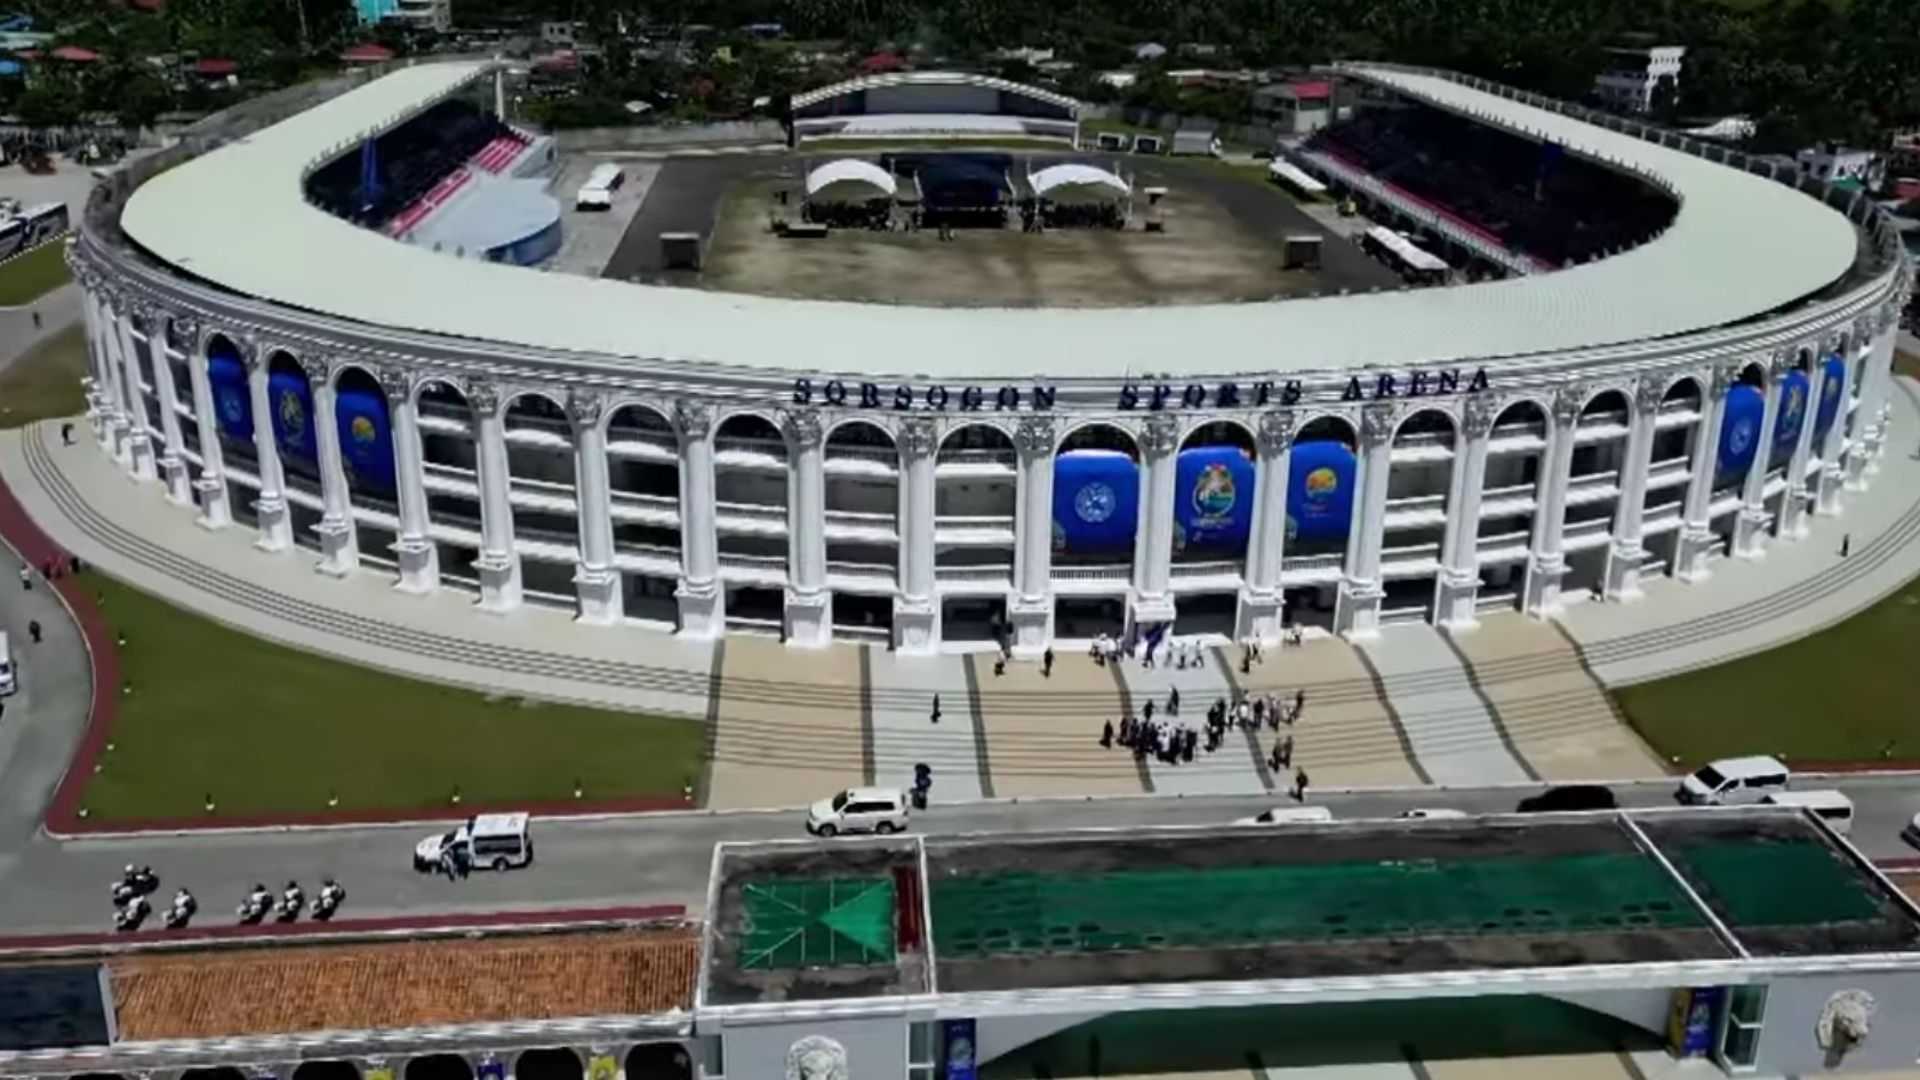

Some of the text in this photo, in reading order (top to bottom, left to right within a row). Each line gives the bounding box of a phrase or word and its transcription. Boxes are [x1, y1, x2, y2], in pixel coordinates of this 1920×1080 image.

[793, 368, 1490, 411] SORSOGON SPORTS ARENA
